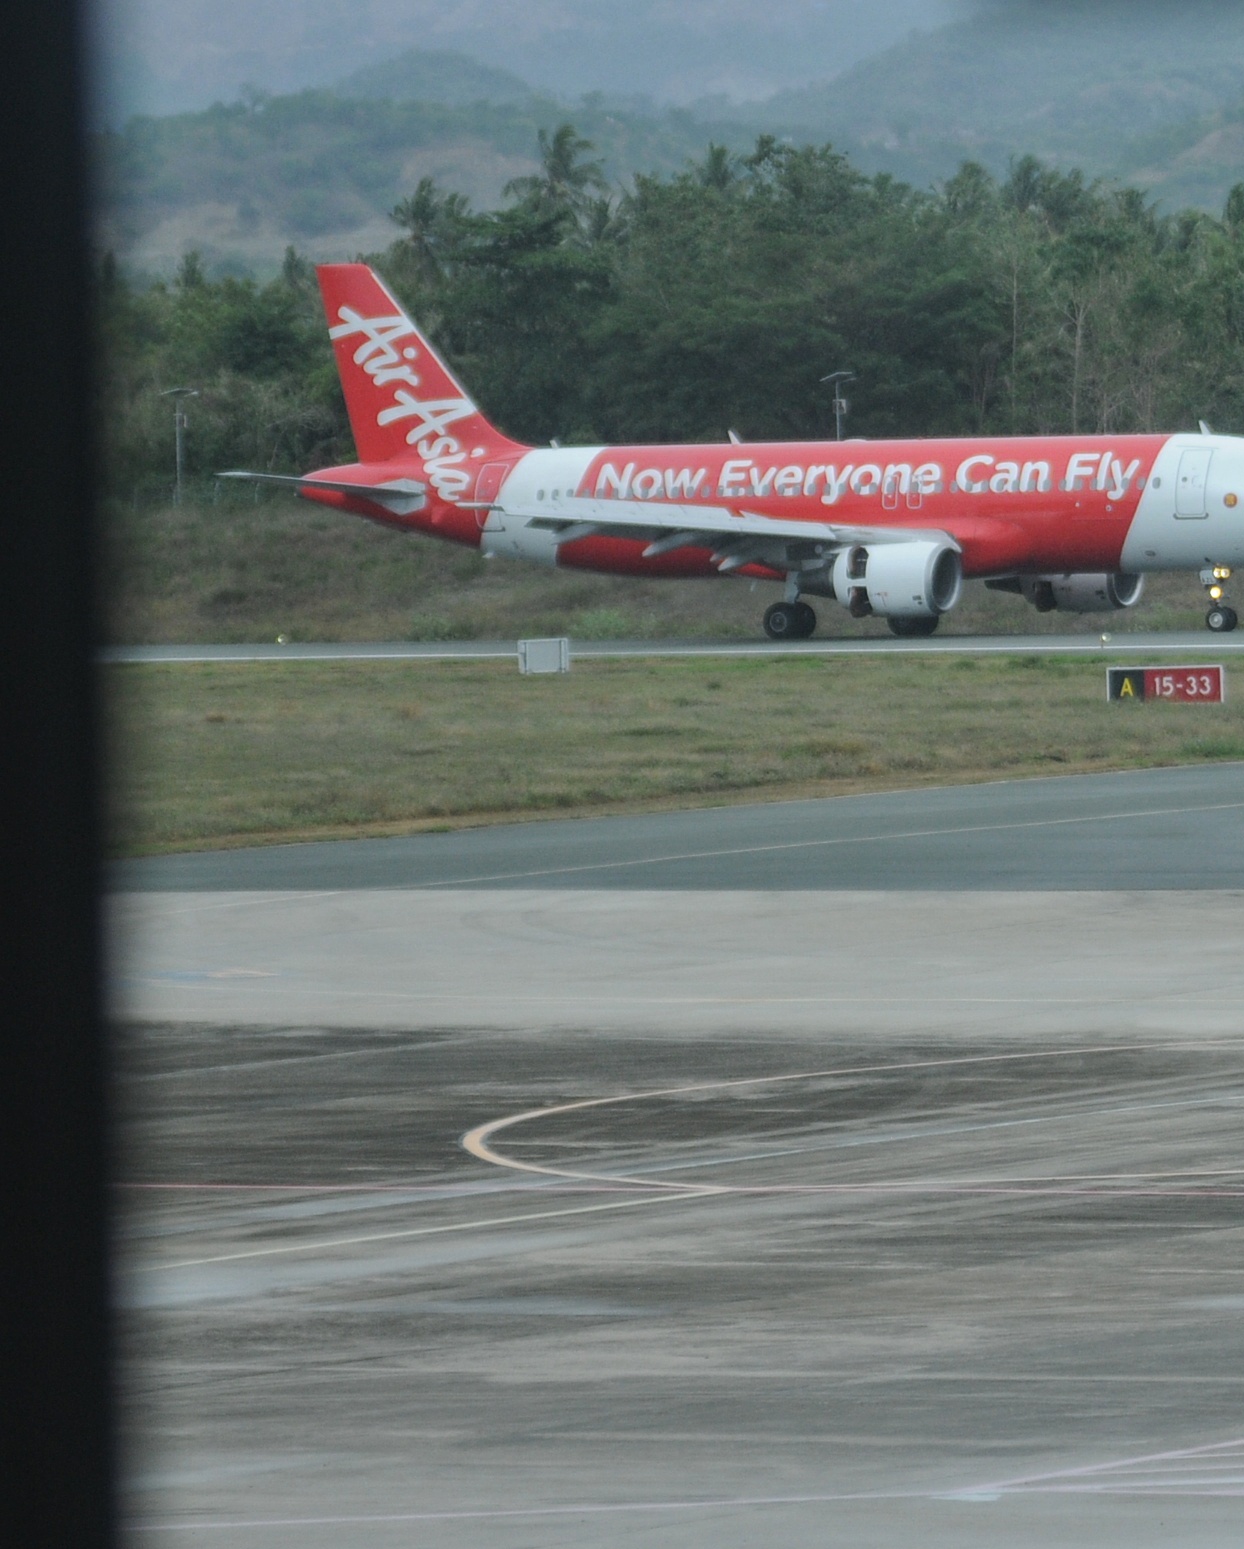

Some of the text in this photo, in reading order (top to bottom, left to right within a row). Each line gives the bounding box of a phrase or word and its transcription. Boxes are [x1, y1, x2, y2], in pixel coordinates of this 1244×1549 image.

[594, 451, 1140, 505] Now Everyone Can Fly
[1120, 675, 1211, 697] A 15-33
